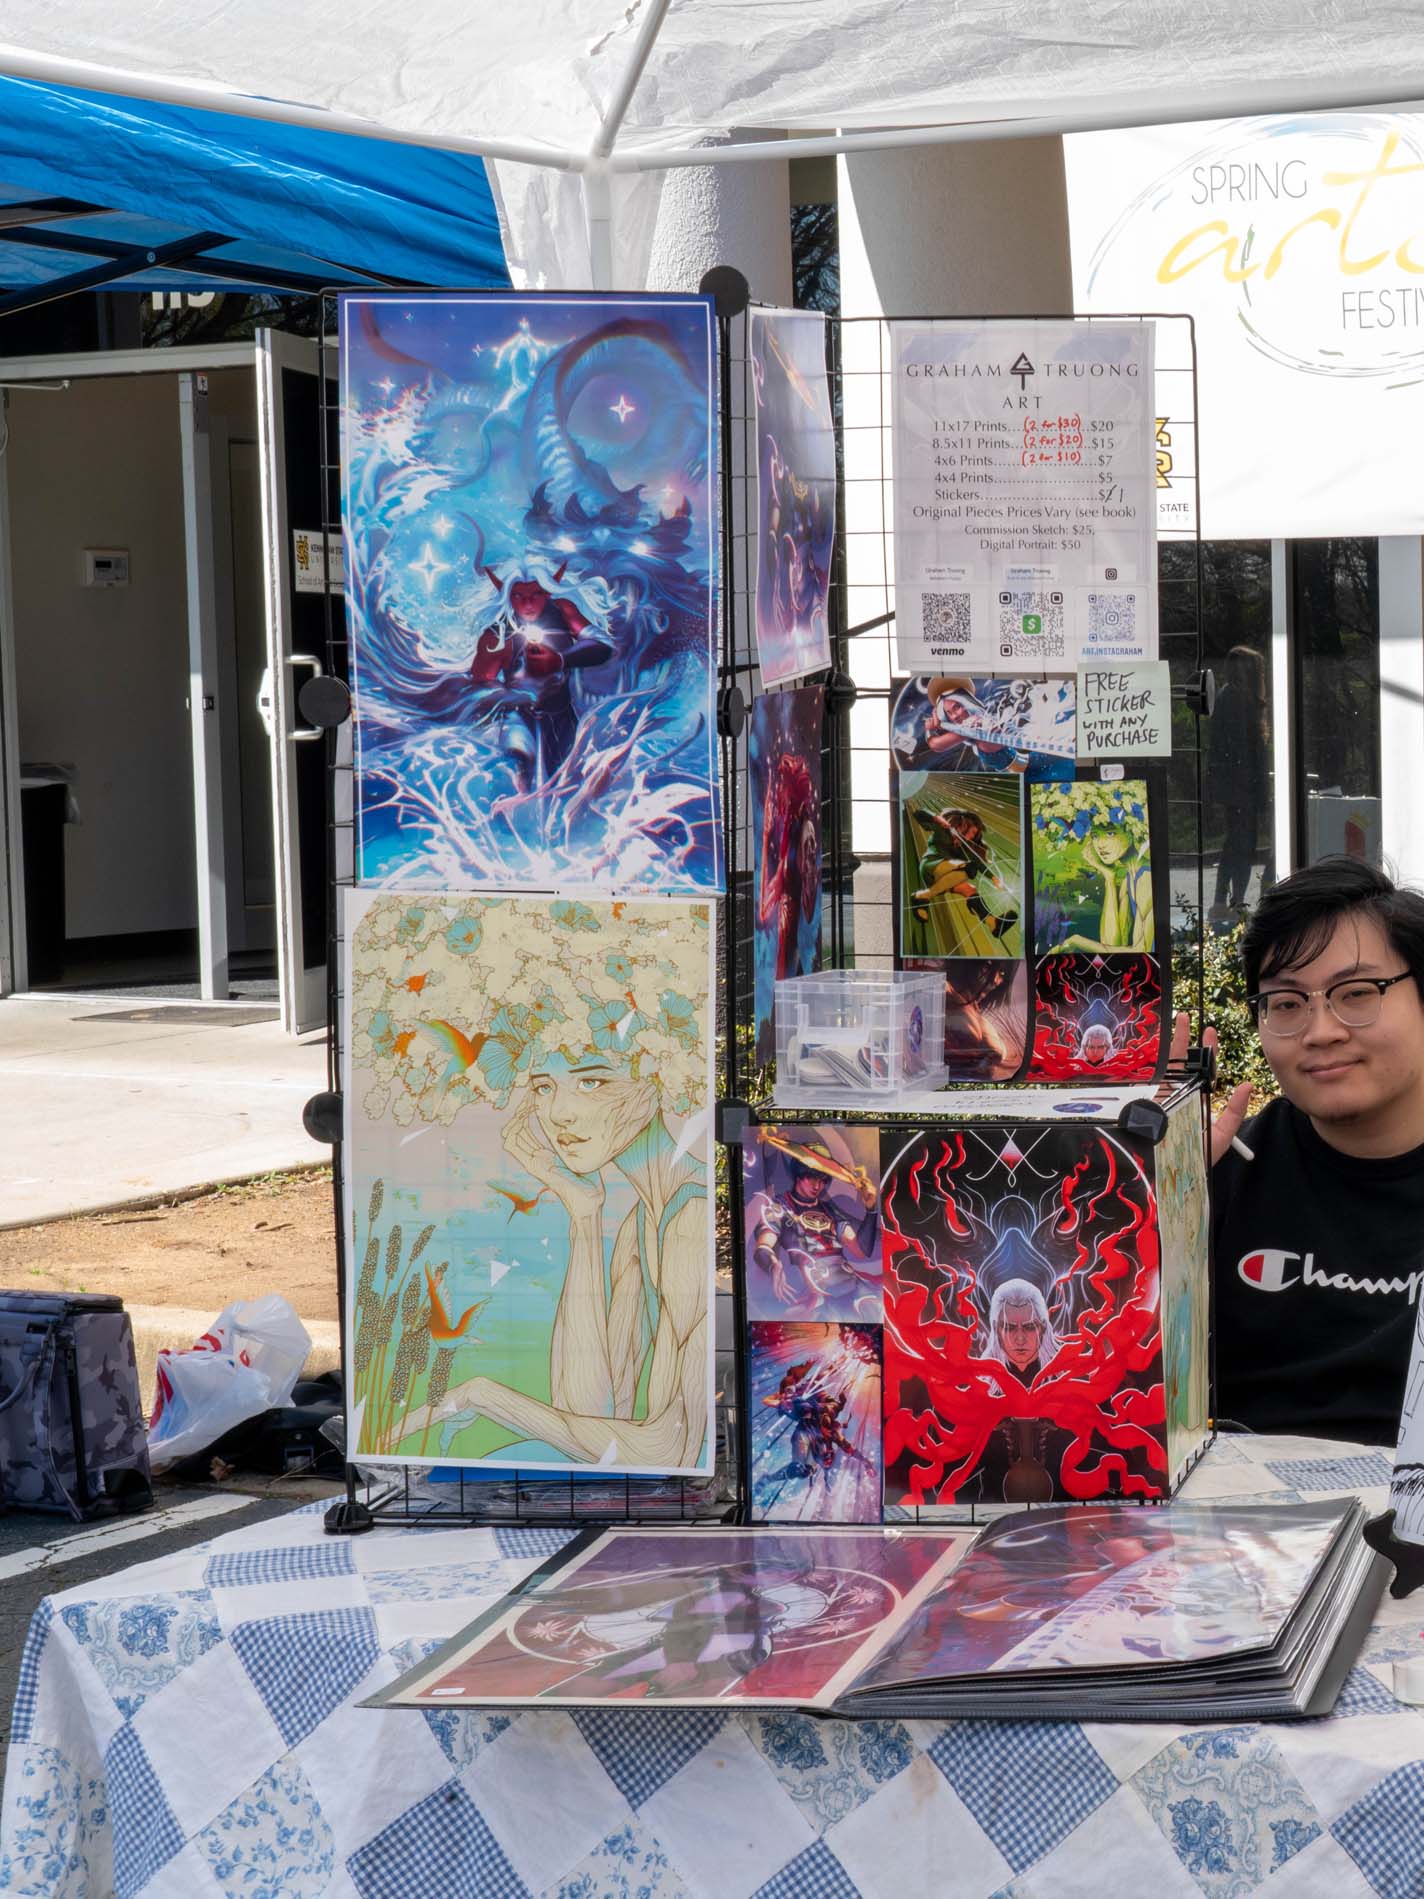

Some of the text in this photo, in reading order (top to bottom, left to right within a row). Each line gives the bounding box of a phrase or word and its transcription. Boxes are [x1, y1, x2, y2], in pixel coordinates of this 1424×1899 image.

[1192, 160, 1308, 206] SPRING
[906, 364, 1139, 377] GRAHAM TRUONG
[1003, 396, 1043, 409] ART
[934, 420, 970, 432] 11x17
[1091, 420, 1114, 432] $20
[932, 437, 974, 449] 8.5x11
[1092, 437, 1114, 450] $15
[934, 455, 956, 466] 4x6
[1098, 455, 1113, 467] $7
[934, 472, 956, 484] 4x4
[1098, 472, 1113, 484] $5
[913, 506, 1137, 520] Original Pieces Prices Vary (see book)
[1159, 503, 1190, 512] STATE
[964, 525, 1028, 536] Commission
[1032, 524, 1068, 536] Sketch:
[980, 540, 1081, 552] Digital Portrait: $50
[931, 648, 965, 656] venmo
[1085, 671, 1135, 697] FREE
[1085, 690, 1155, 714] STICKER
[1083, 713, 1148, 730] WITH ANY
[1087, 728, 1159, 751] PURCHASE
